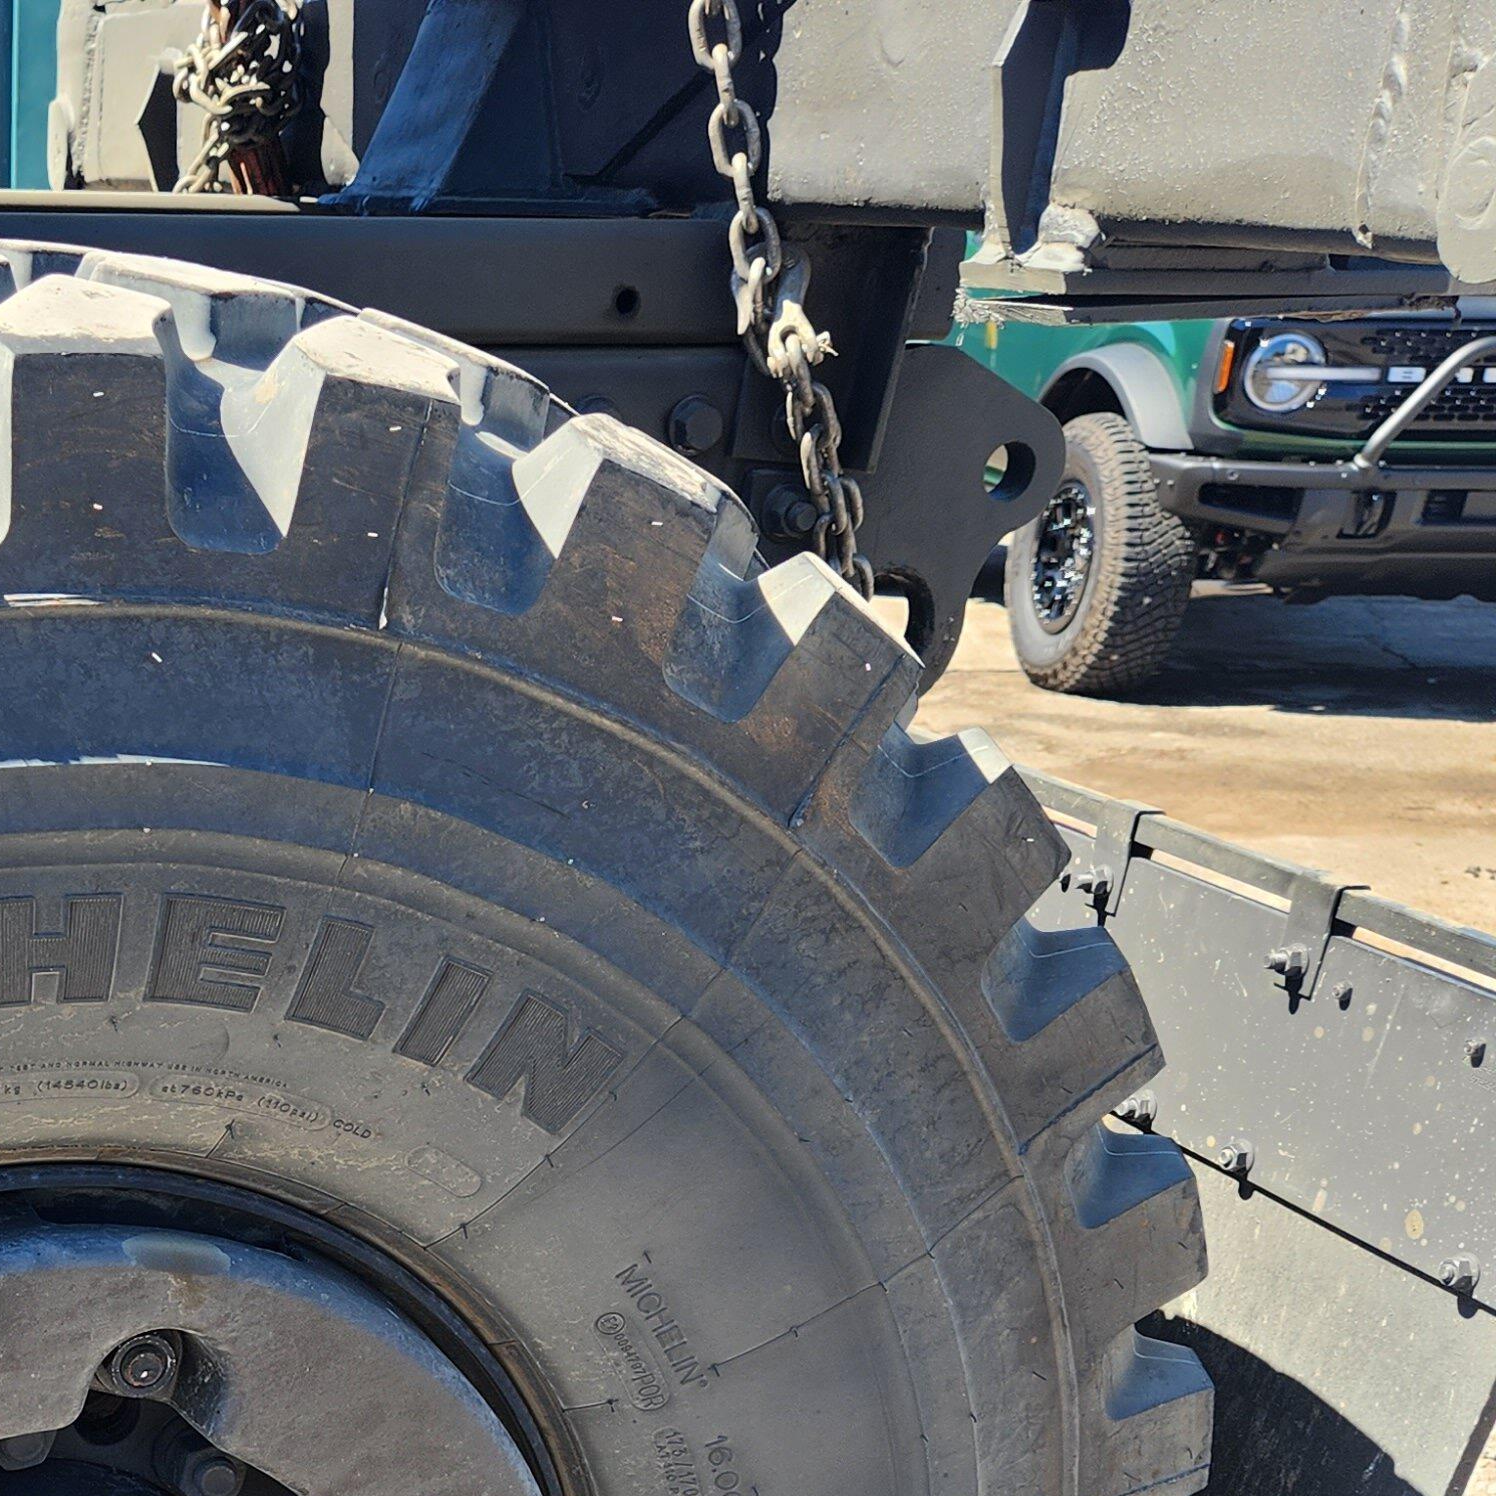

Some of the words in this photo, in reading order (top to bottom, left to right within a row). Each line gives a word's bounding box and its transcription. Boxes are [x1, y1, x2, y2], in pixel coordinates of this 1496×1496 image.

[243, 1073, 288, 1089] AMERICA
[331, 1116, 373, 1141] COLD
[614, 1263, 701, 1386] MICHELIN
